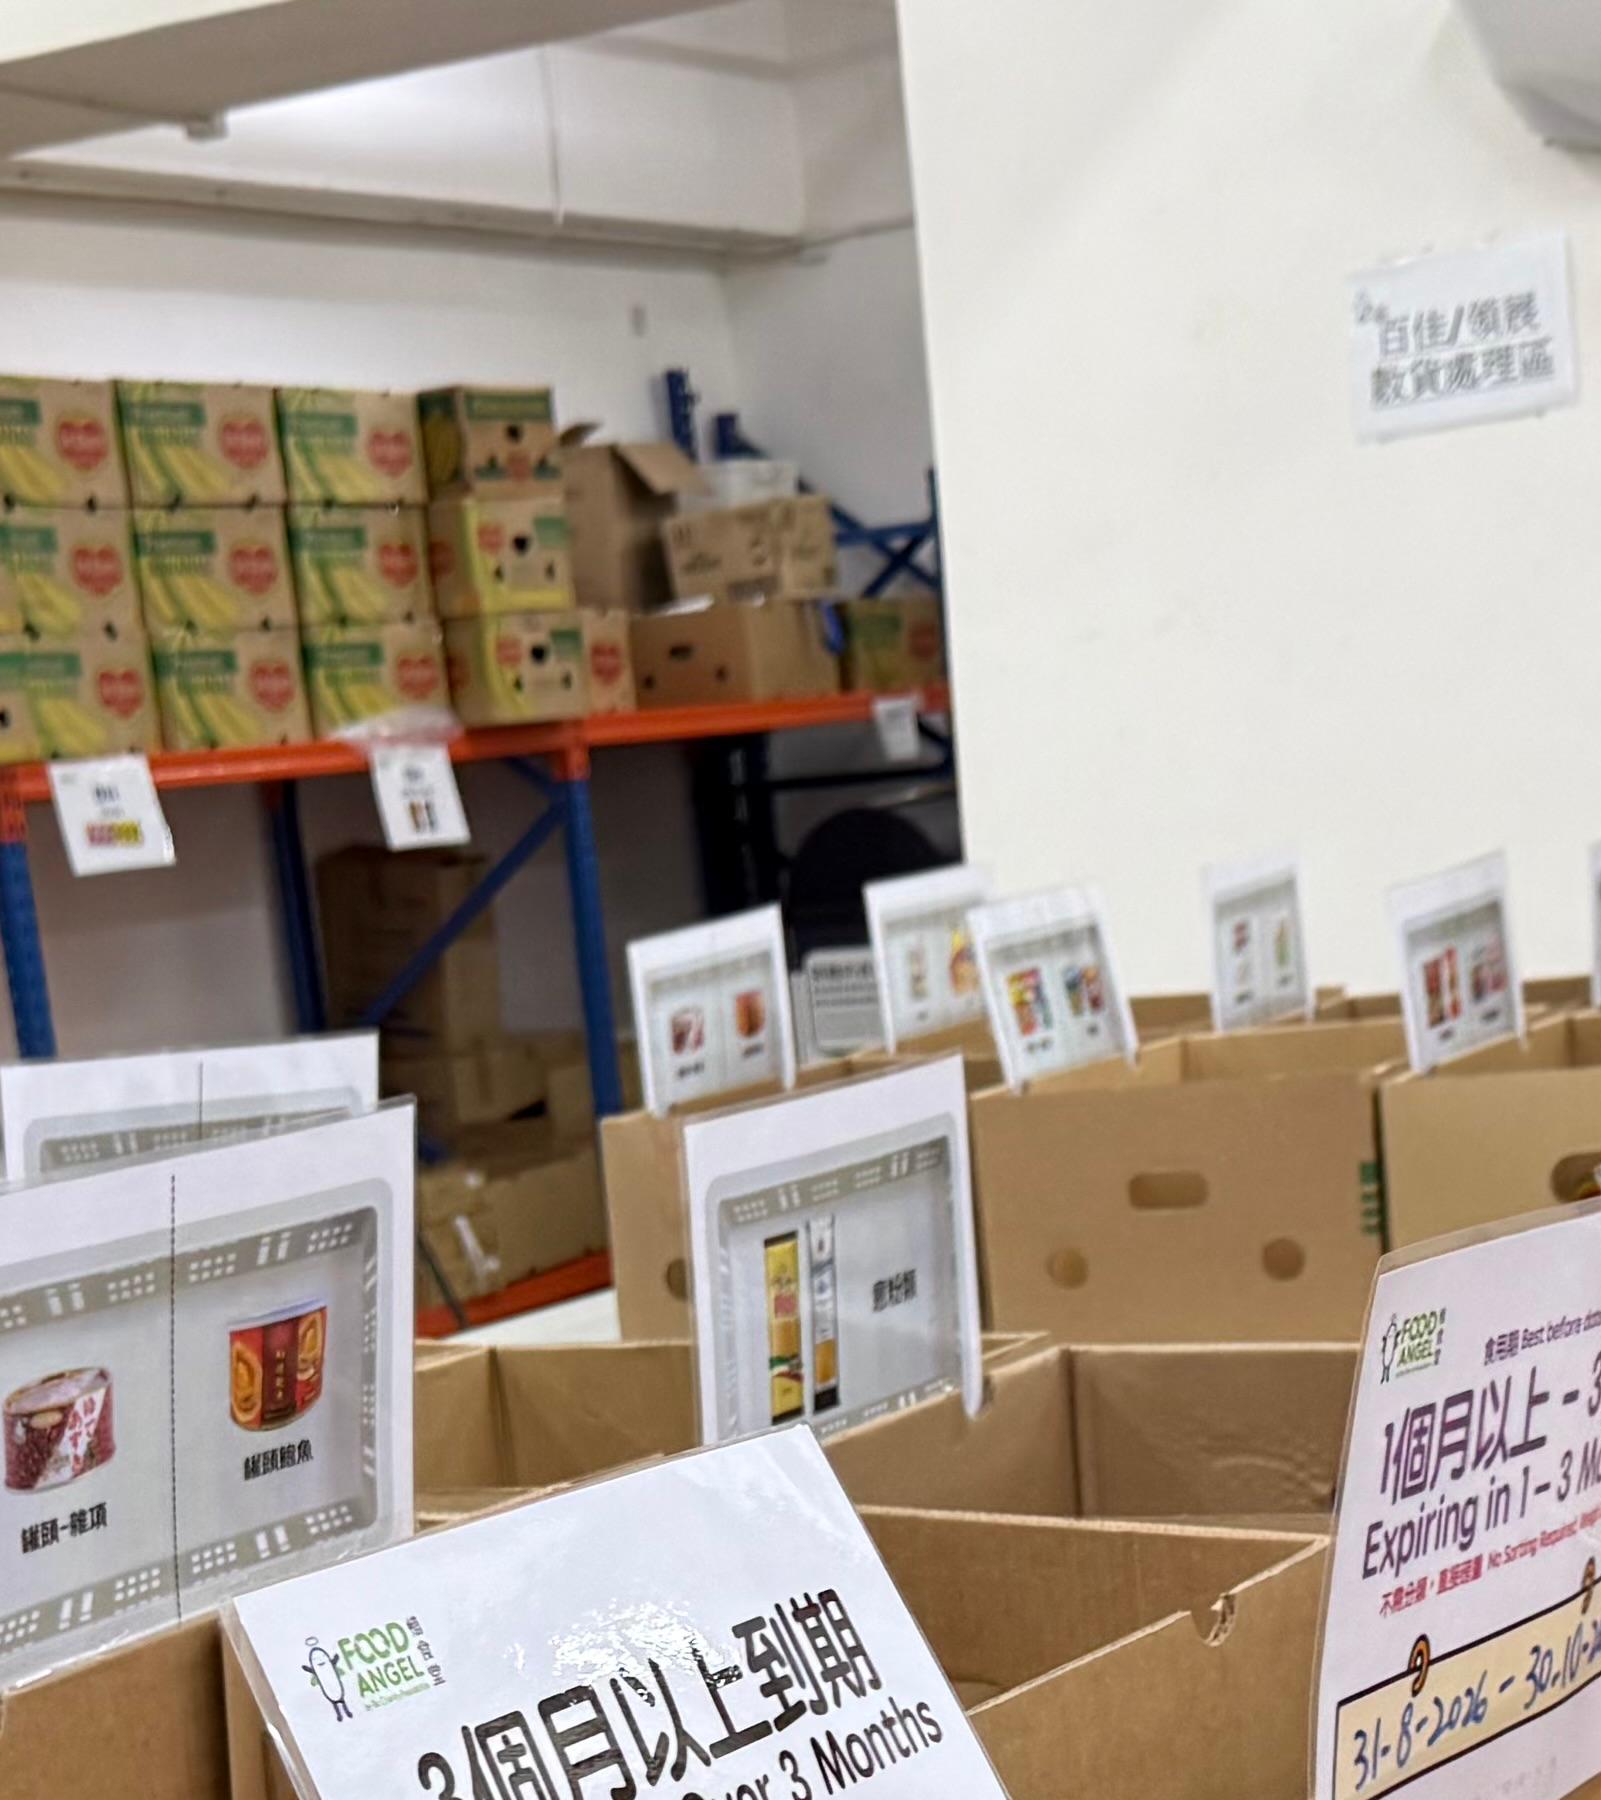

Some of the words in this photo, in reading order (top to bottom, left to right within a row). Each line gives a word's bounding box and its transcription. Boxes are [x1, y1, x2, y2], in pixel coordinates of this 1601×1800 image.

[1400, 1310, 1437, 1340] FOOD
[1520, 1326, 1546, 1351] Best
[1546, 1315, 1583, 1344] before
[1399, 1341, 1435, 1366] ANGEL
[1379, 1365, 1551, 1506] 1個月以上
[243, 1439, 314, 1482] 罐頭鮑魚
[20, 1501, 109, 1555] 罐頭-雜項
[1361, 1494, 1480, 1580] Expiring
[1485, 1474, 1511, 1532] in
[337, 1621, 411, 1671] FOOD
[356, 1655, 425, 1698] ANGEL
[810, 1696, 943, 1797] Months
